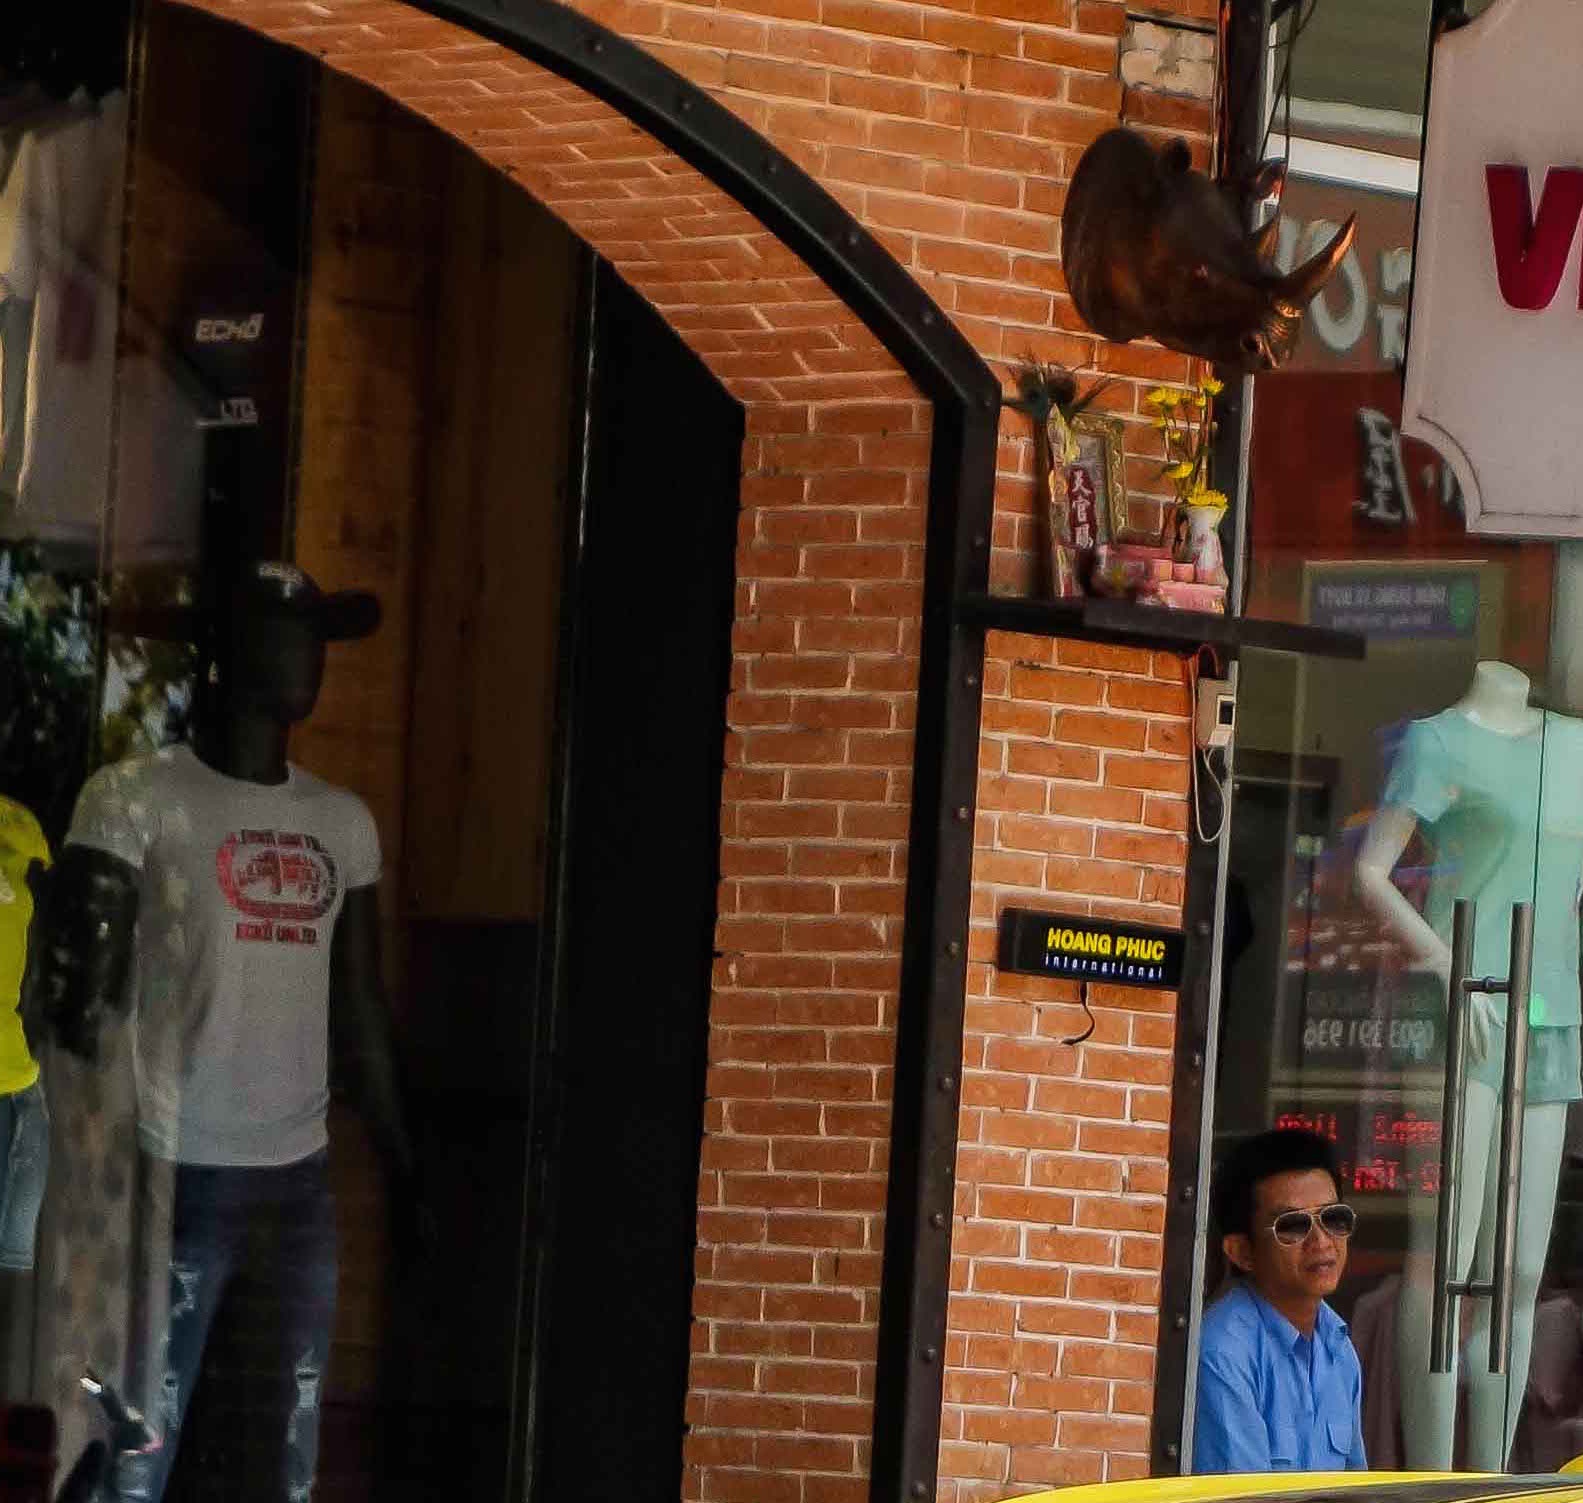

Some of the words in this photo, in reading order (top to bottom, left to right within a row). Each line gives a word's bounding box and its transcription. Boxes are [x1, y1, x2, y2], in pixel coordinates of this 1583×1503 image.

[1047, 927, 1112, 955] HOANG
[1116, 936, 1166, 961] PHUC
[1045, 953, 1163, 979] international
